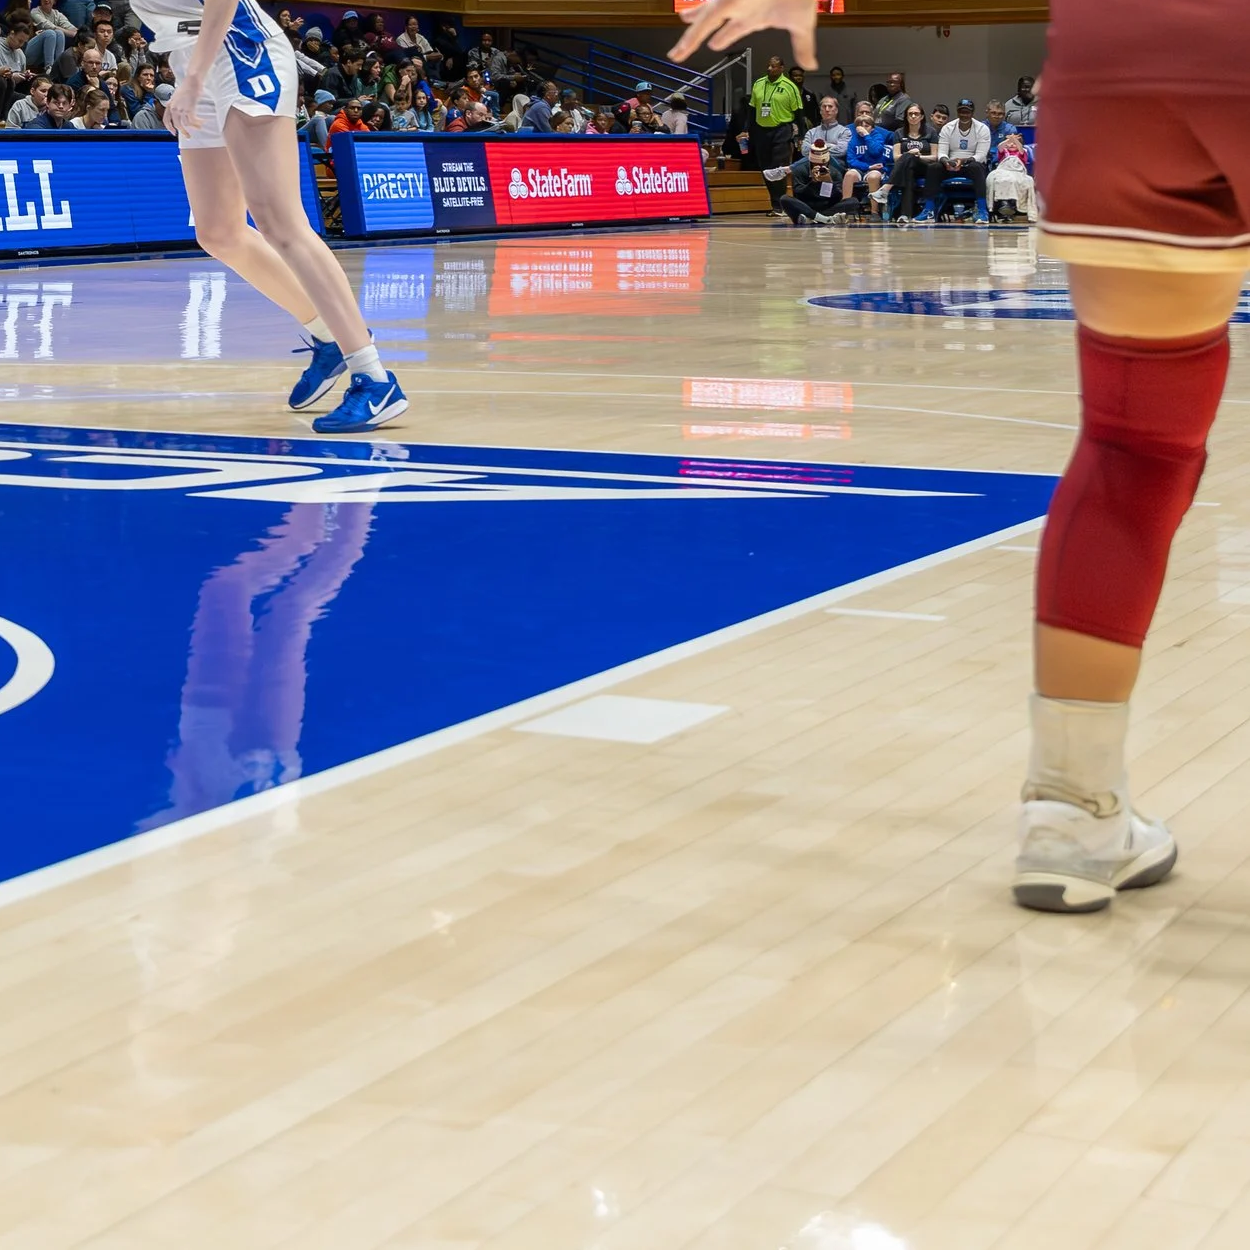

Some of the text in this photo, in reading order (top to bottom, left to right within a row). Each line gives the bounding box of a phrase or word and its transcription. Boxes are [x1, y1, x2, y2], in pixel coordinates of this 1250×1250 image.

[442, 163, 474, 172] STREAM THE
[363, 173, 423, 199] DIRECTV
[433, 177, 486, 192] BLUE DEVILS
[442, 197, 484, 207] SATELLITE-FREE
